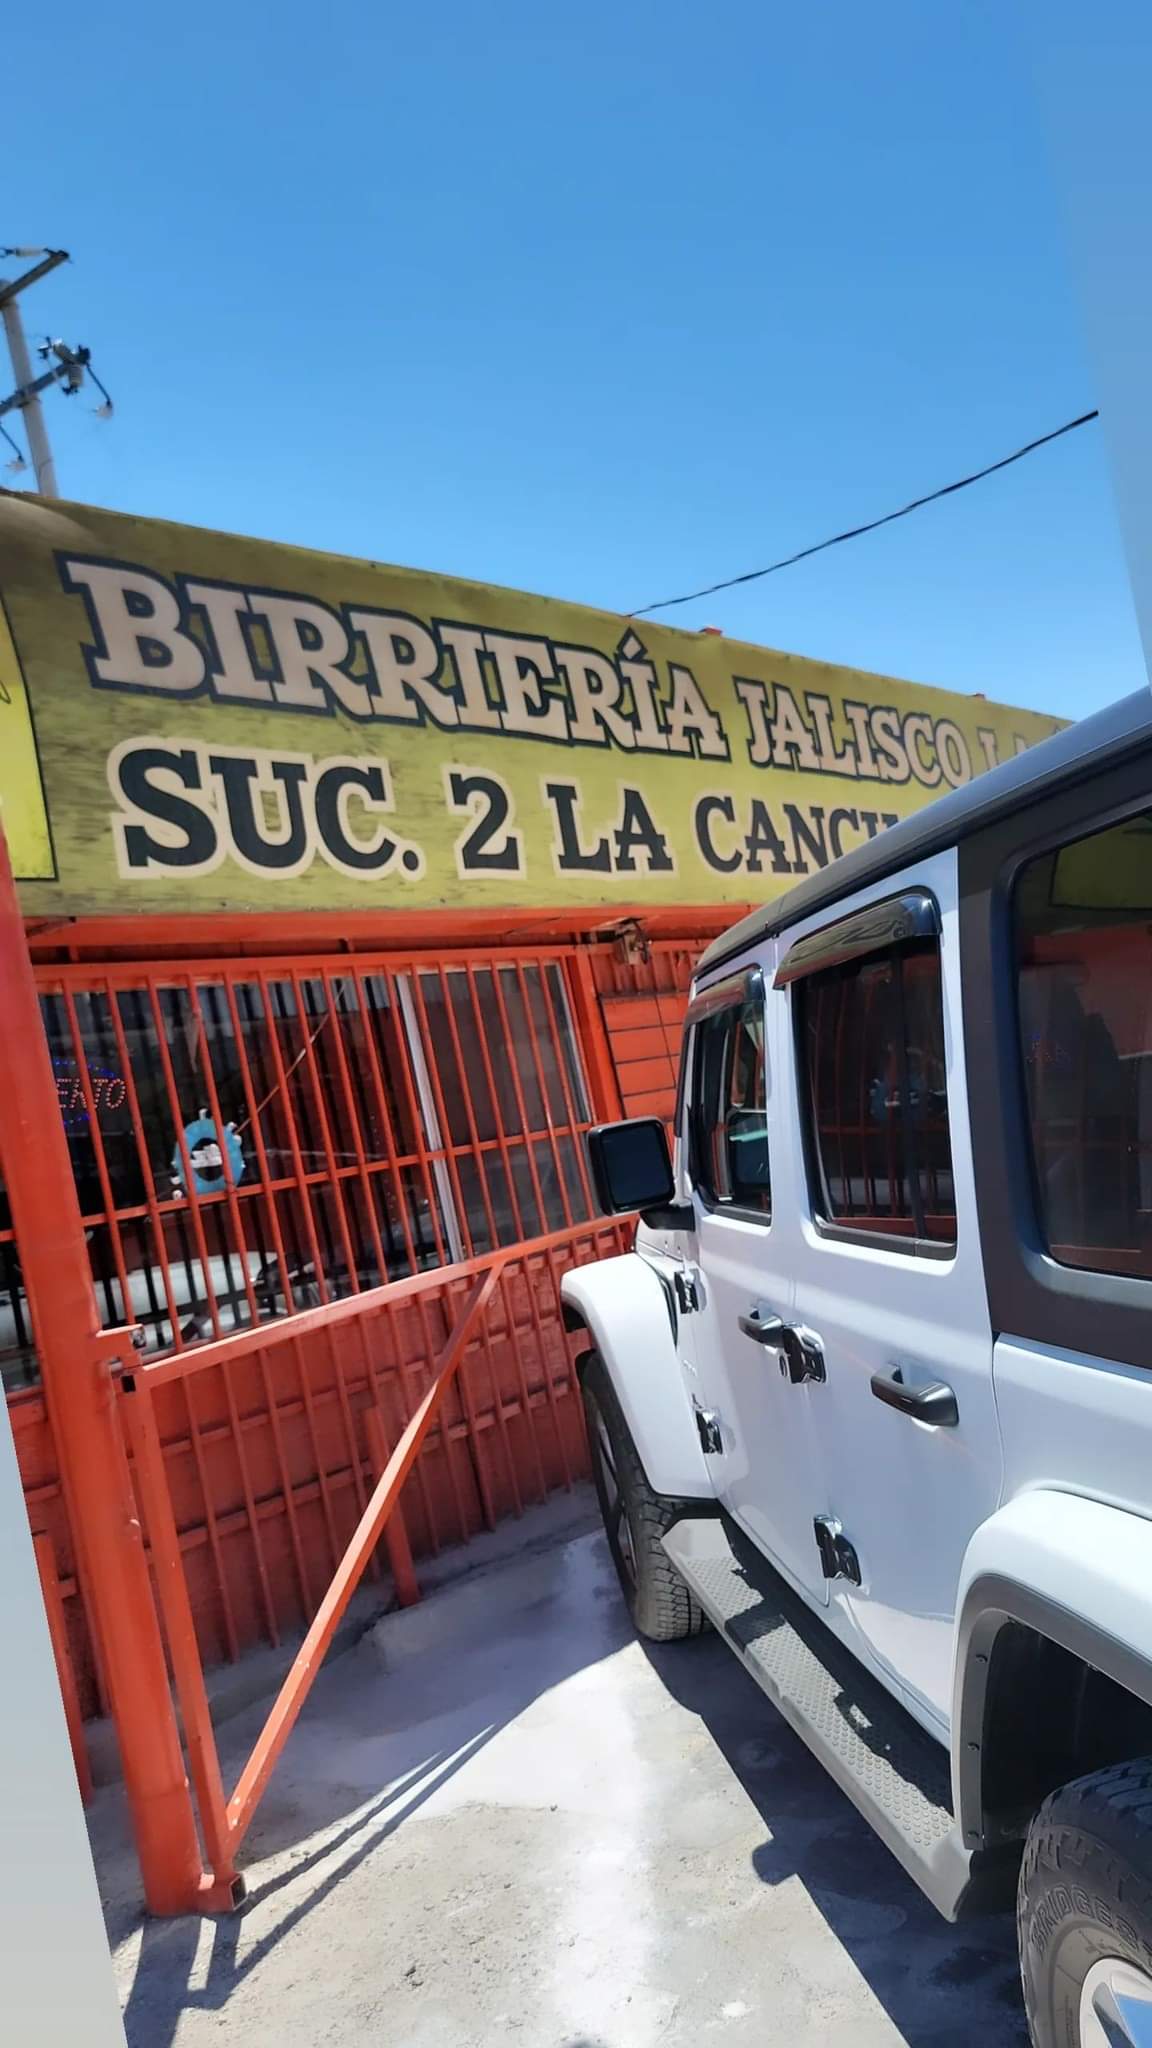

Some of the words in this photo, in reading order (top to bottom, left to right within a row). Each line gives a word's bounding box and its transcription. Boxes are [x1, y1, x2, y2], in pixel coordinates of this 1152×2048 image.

[53, 550, 730, 762] BIRRIERÍA
[732, 675, 973, 788] JALISCO
[112, 742, 423, 876] SUC.
[447, 769, 522, 872] 2
[546, 782, 674, 872] LA
